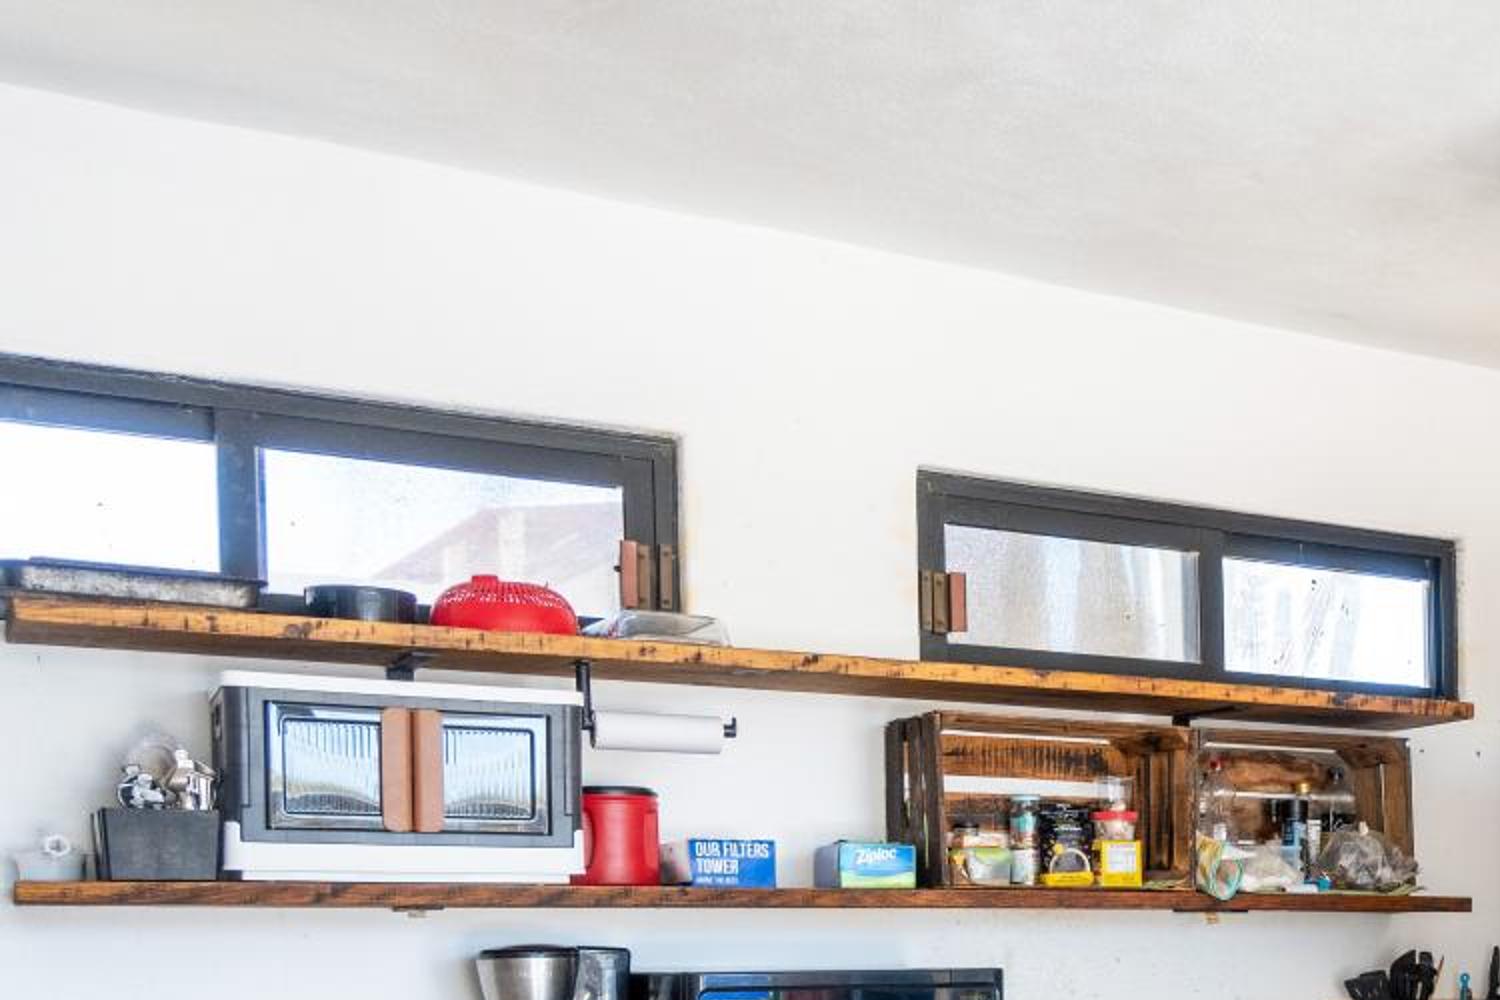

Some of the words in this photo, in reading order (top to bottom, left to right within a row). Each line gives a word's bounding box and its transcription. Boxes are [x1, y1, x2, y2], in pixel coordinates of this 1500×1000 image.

[695, 841, 721, 857] OUR
[723, 841, 769, 859] FILTERS
[855, 847, 897, 865] Ziploc
[696, 858, 739, 875] TOWER
